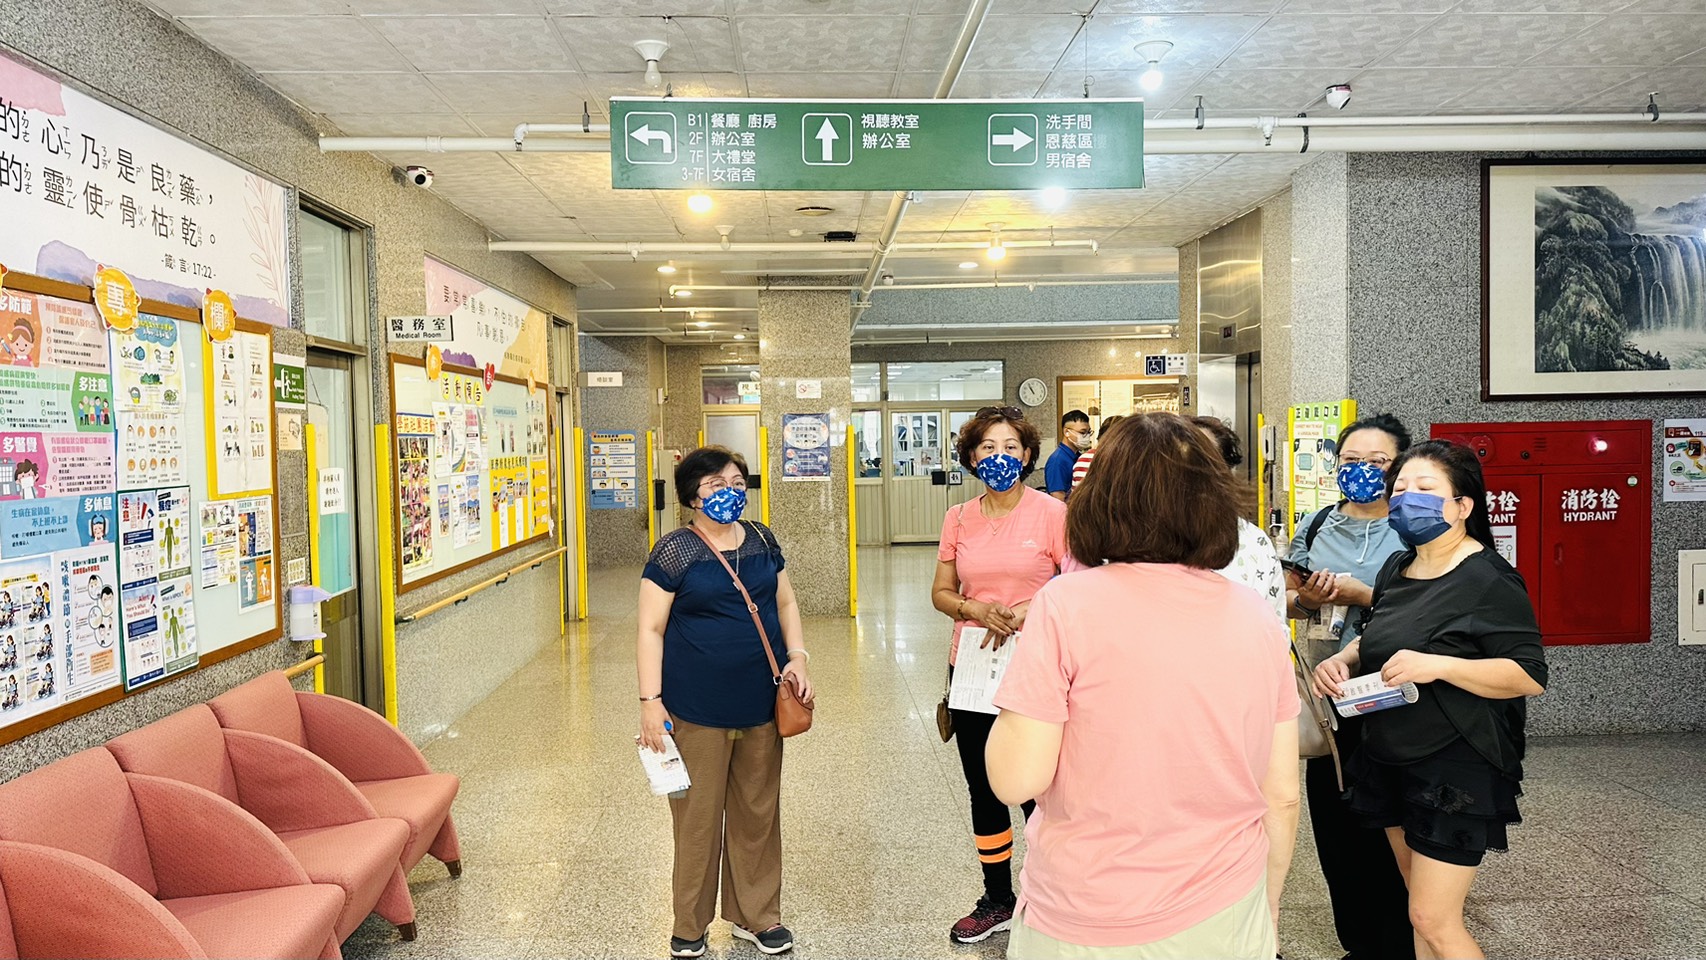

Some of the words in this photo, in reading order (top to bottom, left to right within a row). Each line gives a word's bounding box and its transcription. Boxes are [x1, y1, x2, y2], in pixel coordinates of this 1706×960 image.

[688, 114, 703, 127] B1
[710, 113, 741, 129] 餐廳
[748, 113, 777, 129] 廚房
[861, 113, 920, 129] 視聽教室
[1045, 114, 1092, 130] 洗手間
[689, 132, 703, 145] 2F
[711, 131, 756, 147] 辦公室
[862, 132, 911, 149] 辦公室
[1045, 133, 1093, 149] 恩慈區
[689, 150, 703, 163] 7F
[711, 149, 756, 165] 大禮堂
[1045, 153, 1092, 168] 男宿舍
[682, 167, 704, 181] 3-7F
[711, 167, 756, 182] 女宿舍
[0, 294, 32, 315] 多防範
[391, 317, 446, 332] 醫務室
[79, 375, 108, 393] 多注意
[84, 496, 113, 513] 多休息
[1561, 487, 1621, 510] 消防栓
[1563, 510, 1617, 522] HYDRANT
